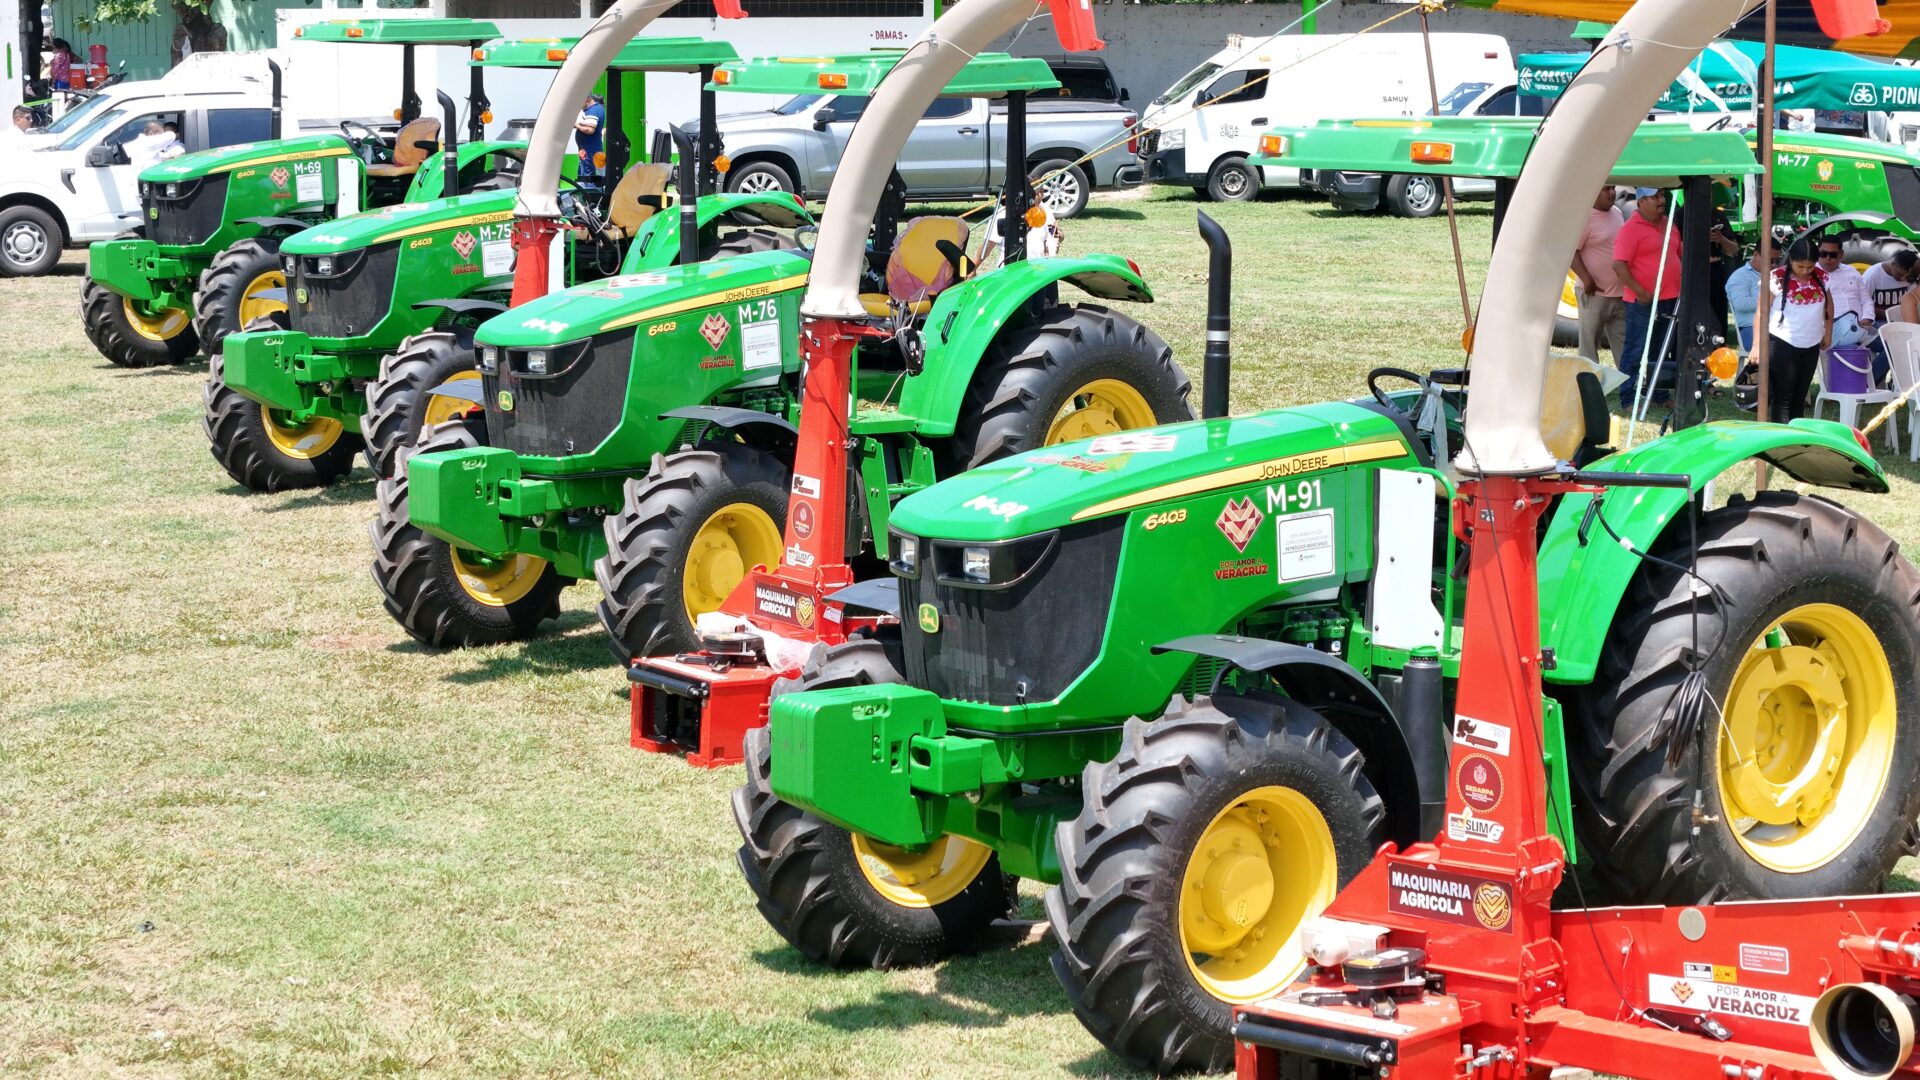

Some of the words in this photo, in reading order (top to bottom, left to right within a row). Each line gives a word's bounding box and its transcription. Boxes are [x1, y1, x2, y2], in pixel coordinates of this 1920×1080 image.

[875, 30, 903, 40] DAMAS
[1882, 86, 1920, 104] PION
[294, 161, 321, 175] M-69
[1777, 154, 1810, 167] M-77
[471, 216, 488, 224] JOHN
[488, 213, 509, 222] DEERE
[479, 223, 512, 241] M-75
[410, 237, 433, 249] 6403
[724, 290, 745, 302] JOHN
[745, 285, 771, 297] DEERE
[738, 298, 777, 324] M-76
[648, 321, 677, 336] 6403
[700, 359, 735, 370] VERACRUZ
[1259, 465, 1290, 480] JOHN
[1292, 455, 1329, 473] DEERE
[1266, 479, 1322, 514] M-91
[1143, 508, 1187, 530] 6403
[1220, 560, 1235, 569] POR
[1236, 557, 1256, 567] AMOR
[1256, 556, 1262, 565] A
[1215, 564, 1268, 581] VERACRUZ
[756, 586, 796, 608] MAQUINARIA
[759, 600, 792, 619] AGRICOLA
[1465, 784, 1495, 796] SEDARPA
[1465, 819, 1489, 834] SLIM
[1391, 871, 1472, 900] MAQUINARIA
[1399, 889, 1464, 916] AGRICOLA
[1716, 984, 1740, 997] POR
[1743, 989, 1778, 1003] AMOR
[1780, 994, 1789, 1004] A
[1707, 994, 1800, 1022] VERACRUZ
